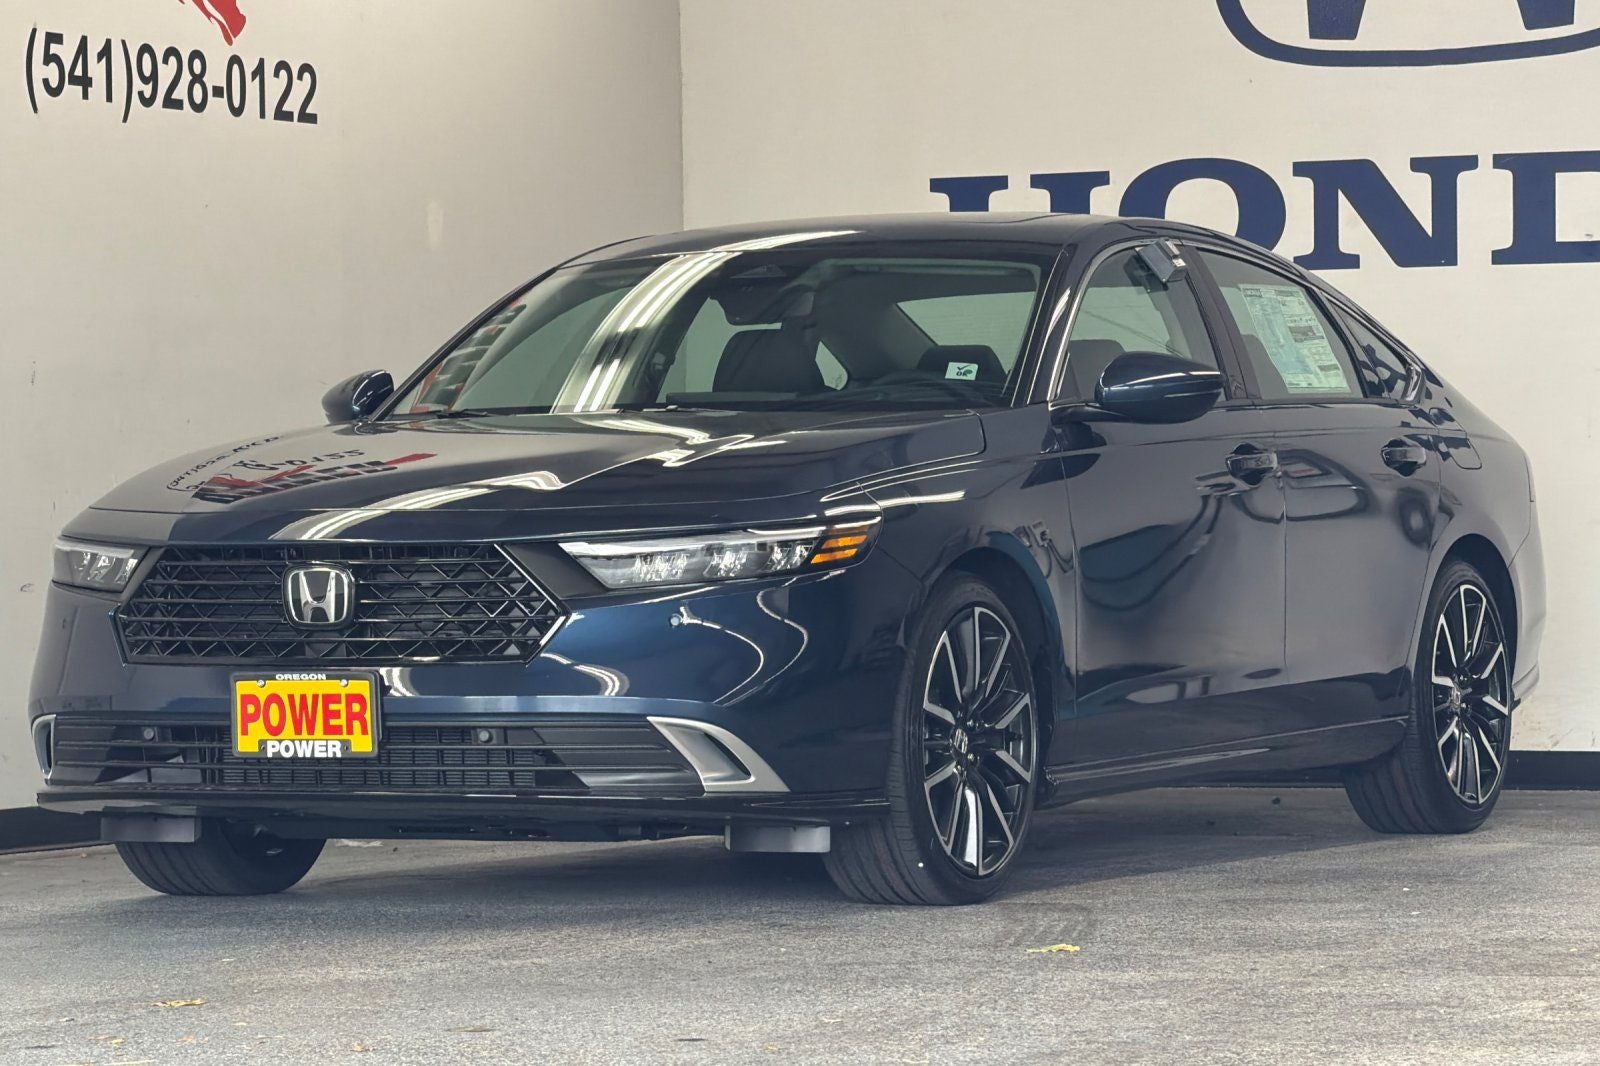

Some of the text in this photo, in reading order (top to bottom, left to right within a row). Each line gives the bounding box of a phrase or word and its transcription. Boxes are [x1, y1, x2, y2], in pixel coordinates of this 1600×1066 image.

[26, 28, 318, 125] (541)928-0122
[275, 673, 327, 681] OREGON
[240, 692, 369, 737] POWER
[266, 740, 342, 758] POWER
